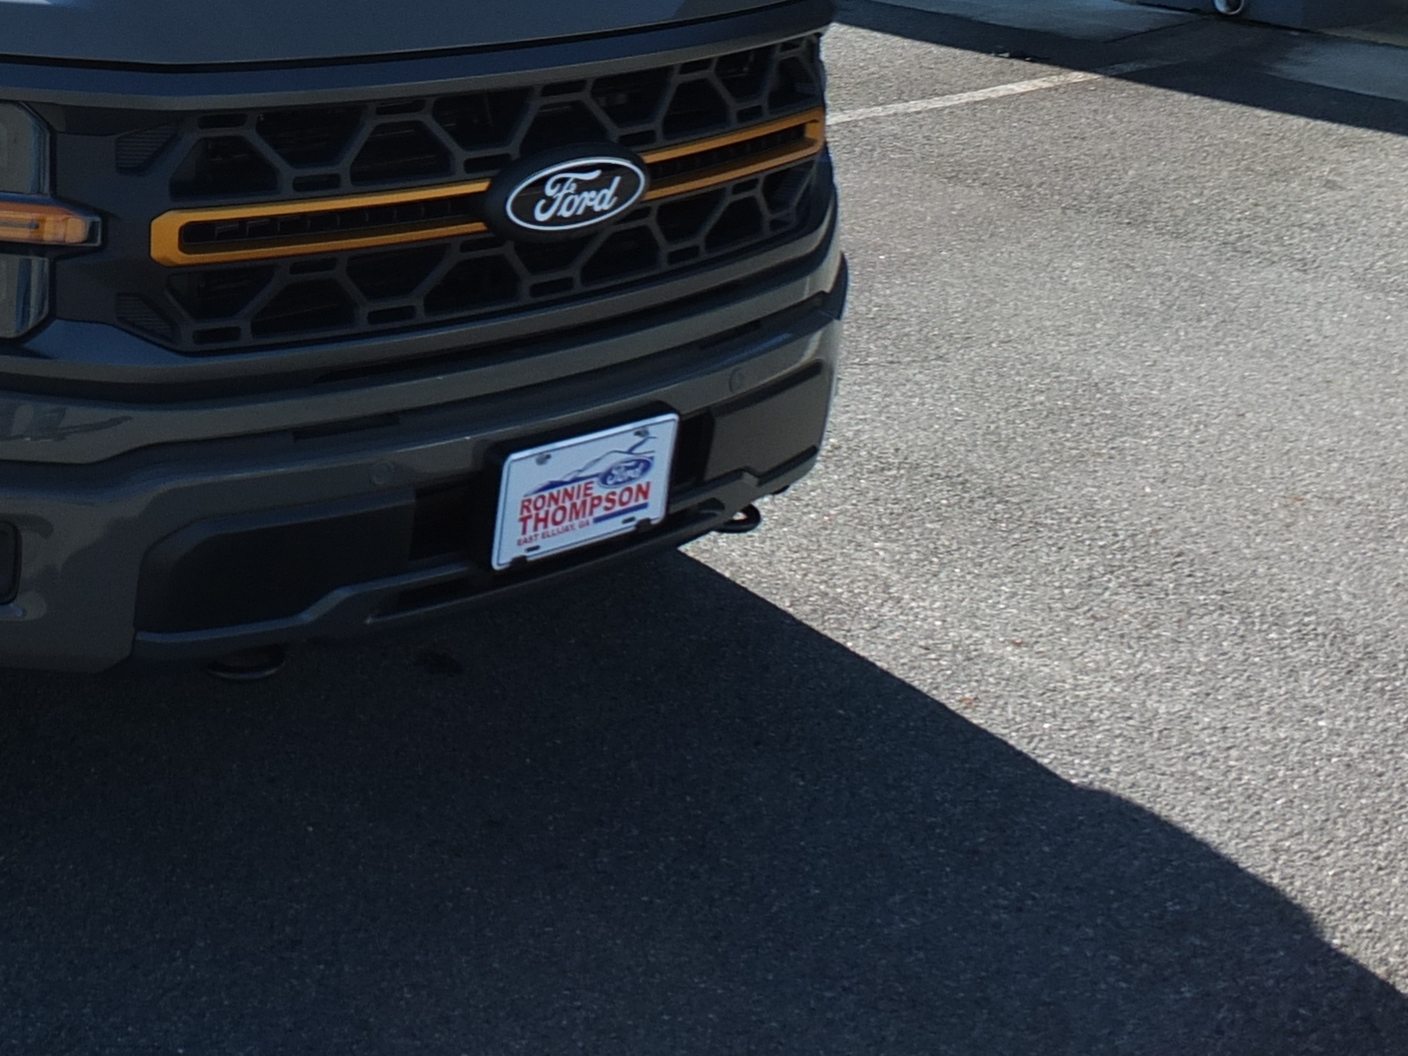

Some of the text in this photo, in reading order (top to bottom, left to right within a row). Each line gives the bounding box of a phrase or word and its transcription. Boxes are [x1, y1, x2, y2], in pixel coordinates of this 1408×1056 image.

[534, 169, 622, 222] Ford
[606, 459, 644, 486] Ford
[518, 481, 652, 536] THOMPSON
[519, 481, 595, 516] RONNIE
[516, 533, 540, 546] EAST
